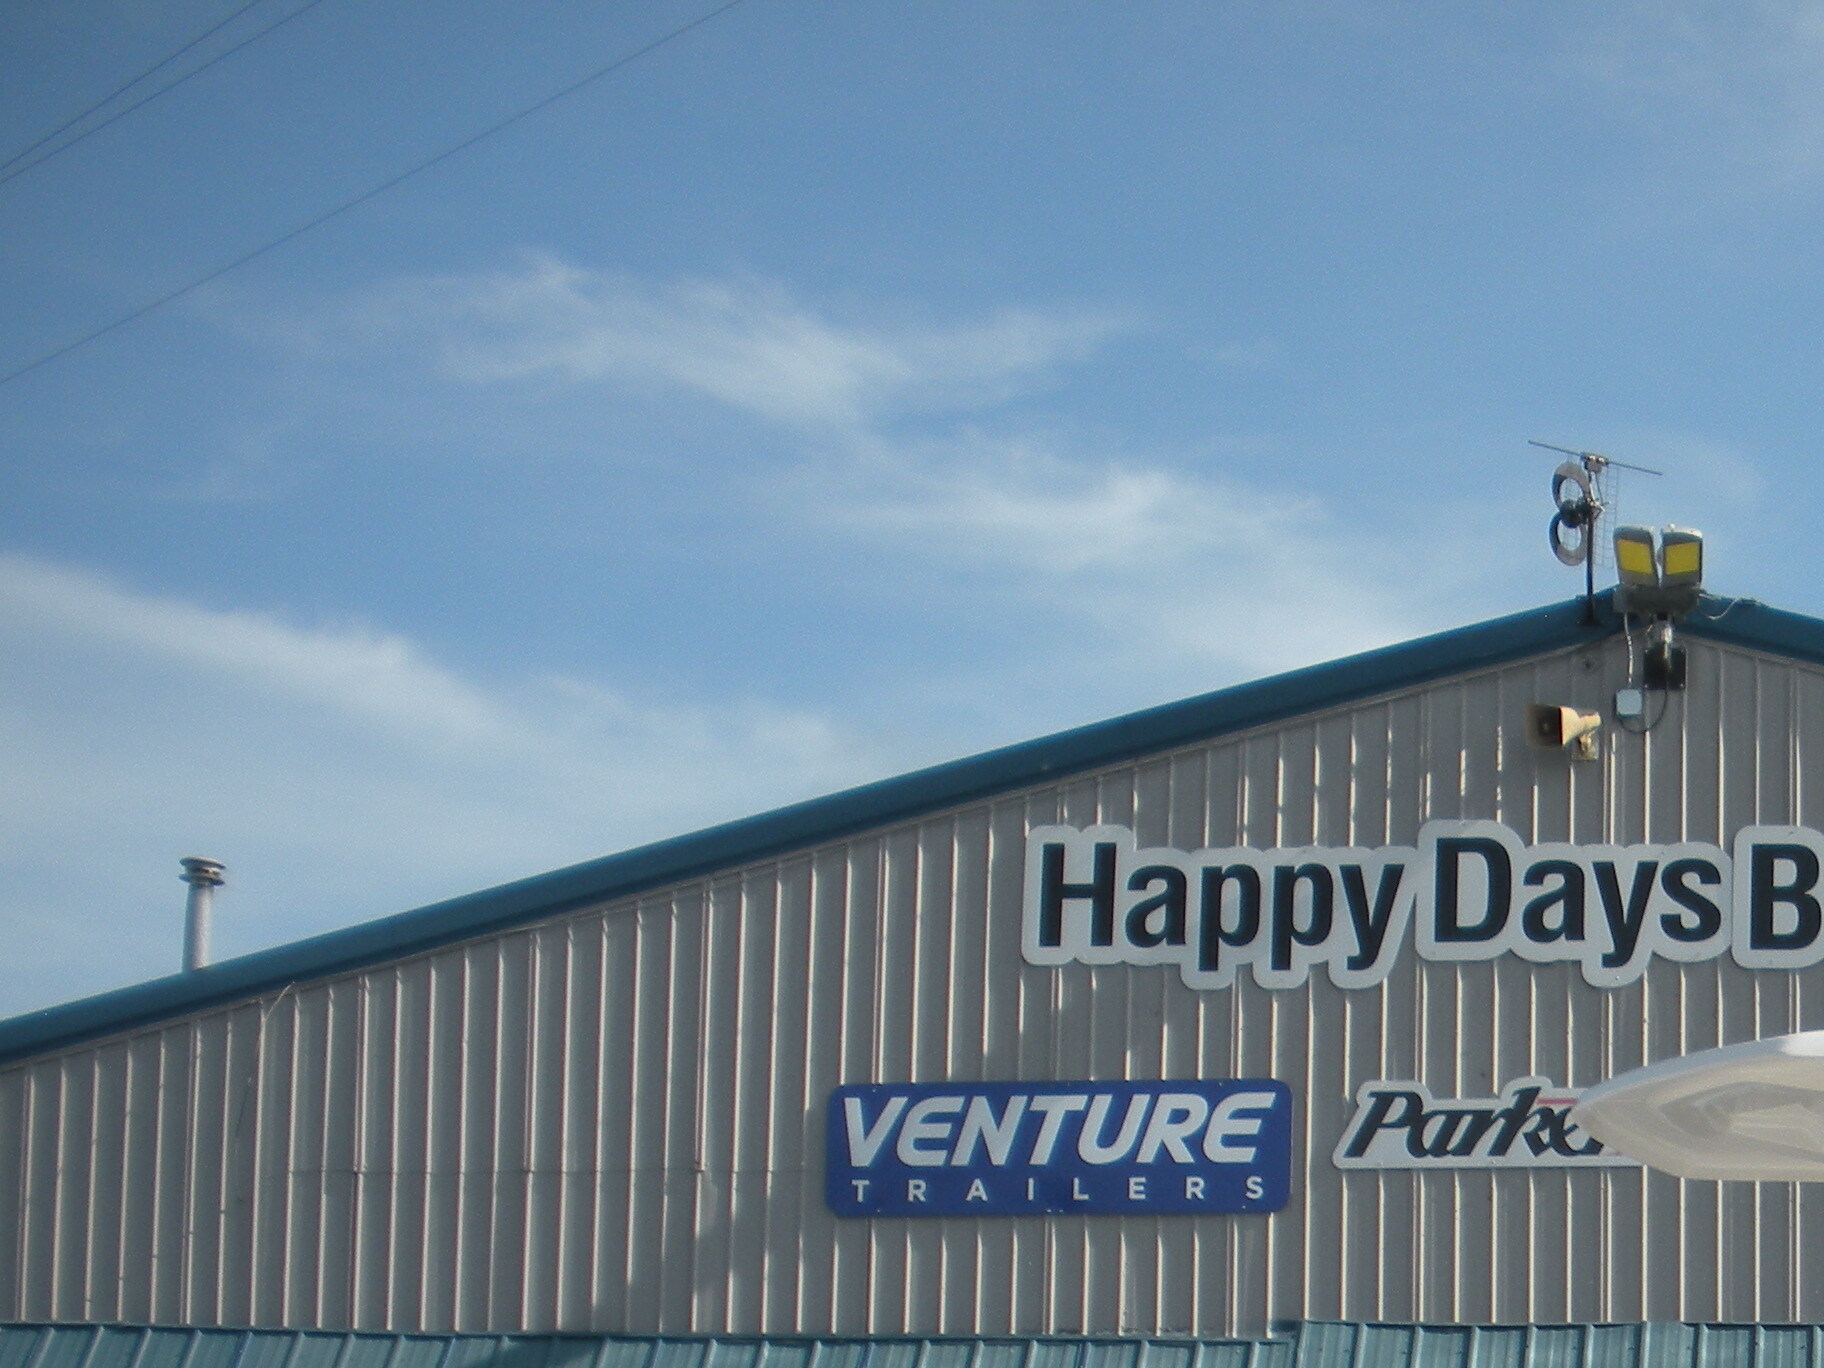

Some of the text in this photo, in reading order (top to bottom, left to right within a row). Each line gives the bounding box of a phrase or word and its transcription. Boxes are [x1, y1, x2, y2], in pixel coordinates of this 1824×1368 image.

[1037, 840, 1406, 972] Happy
[1433, 836, 1723, 968] Days
[843, 1091, 1277, 1168] VENTURE
[1343, 1086, 1604, 1158] Parke
[851, 1175, 1265, 1202] TRAILERS
